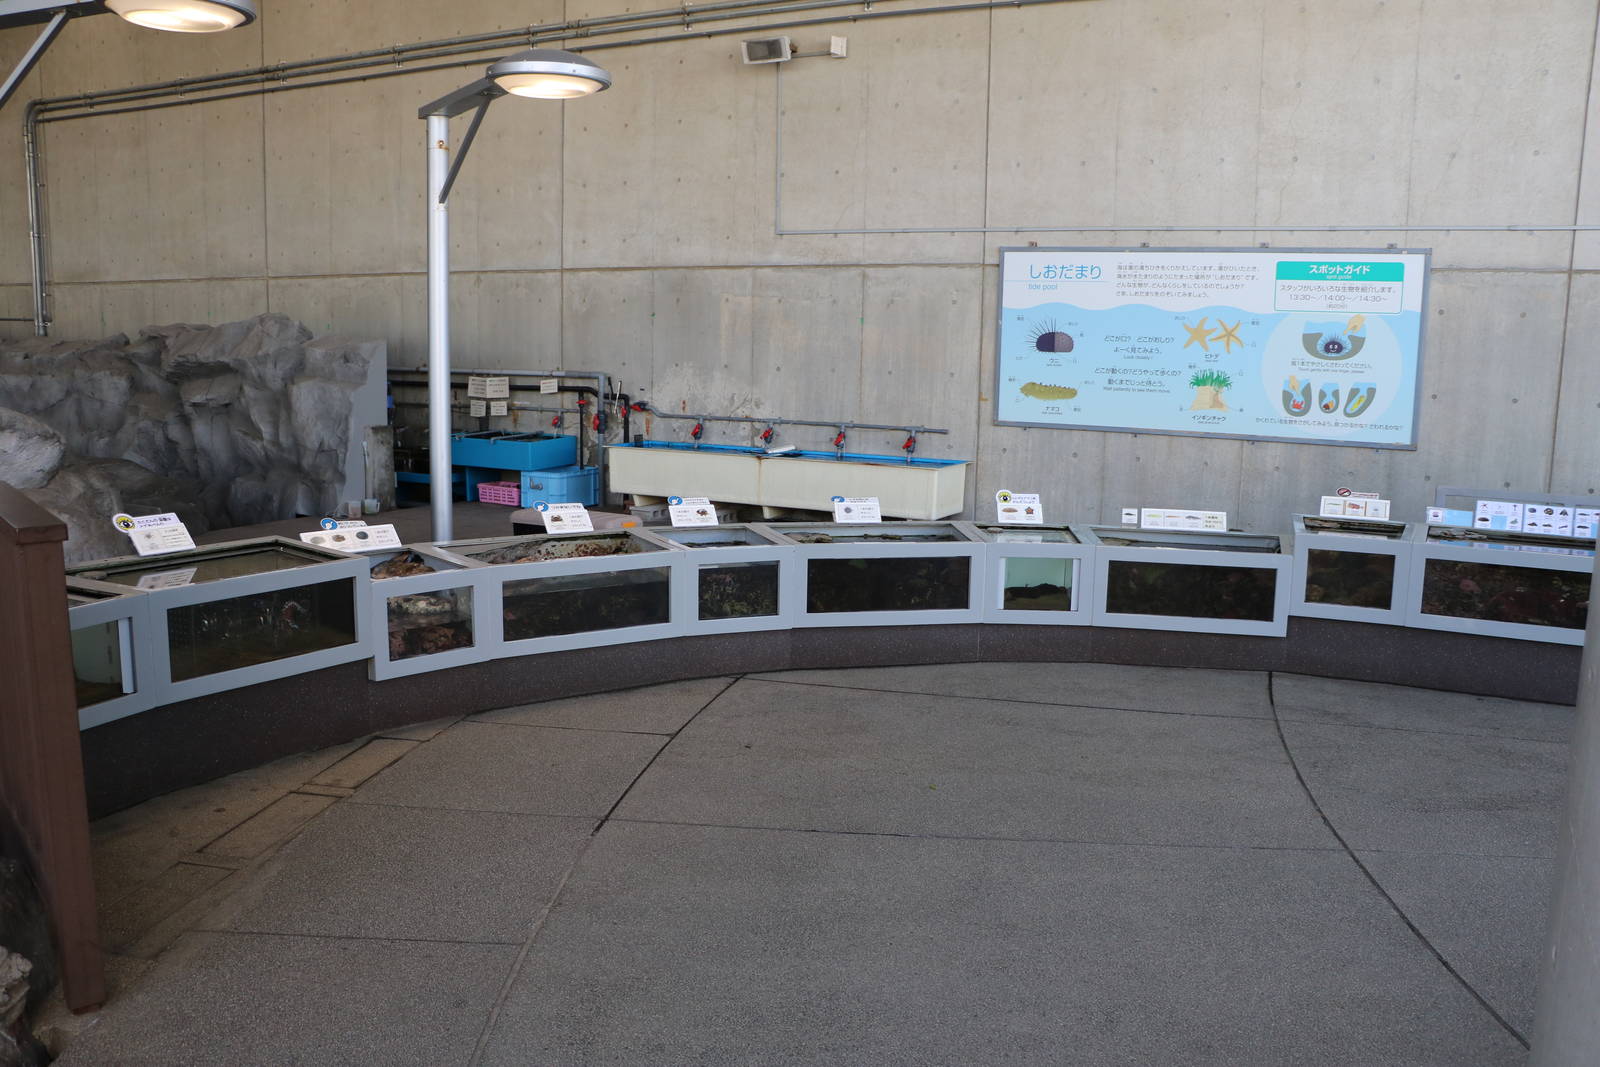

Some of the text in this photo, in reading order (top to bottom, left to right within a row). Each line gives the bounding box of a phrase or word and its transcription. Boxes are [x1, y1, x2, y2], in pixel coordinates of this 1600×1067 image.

[1030, 264, 1102, 280] しおだまり
[1309, 264, 1371, 275] スポットガイド
[1042, 283, 1058, 291] pool
